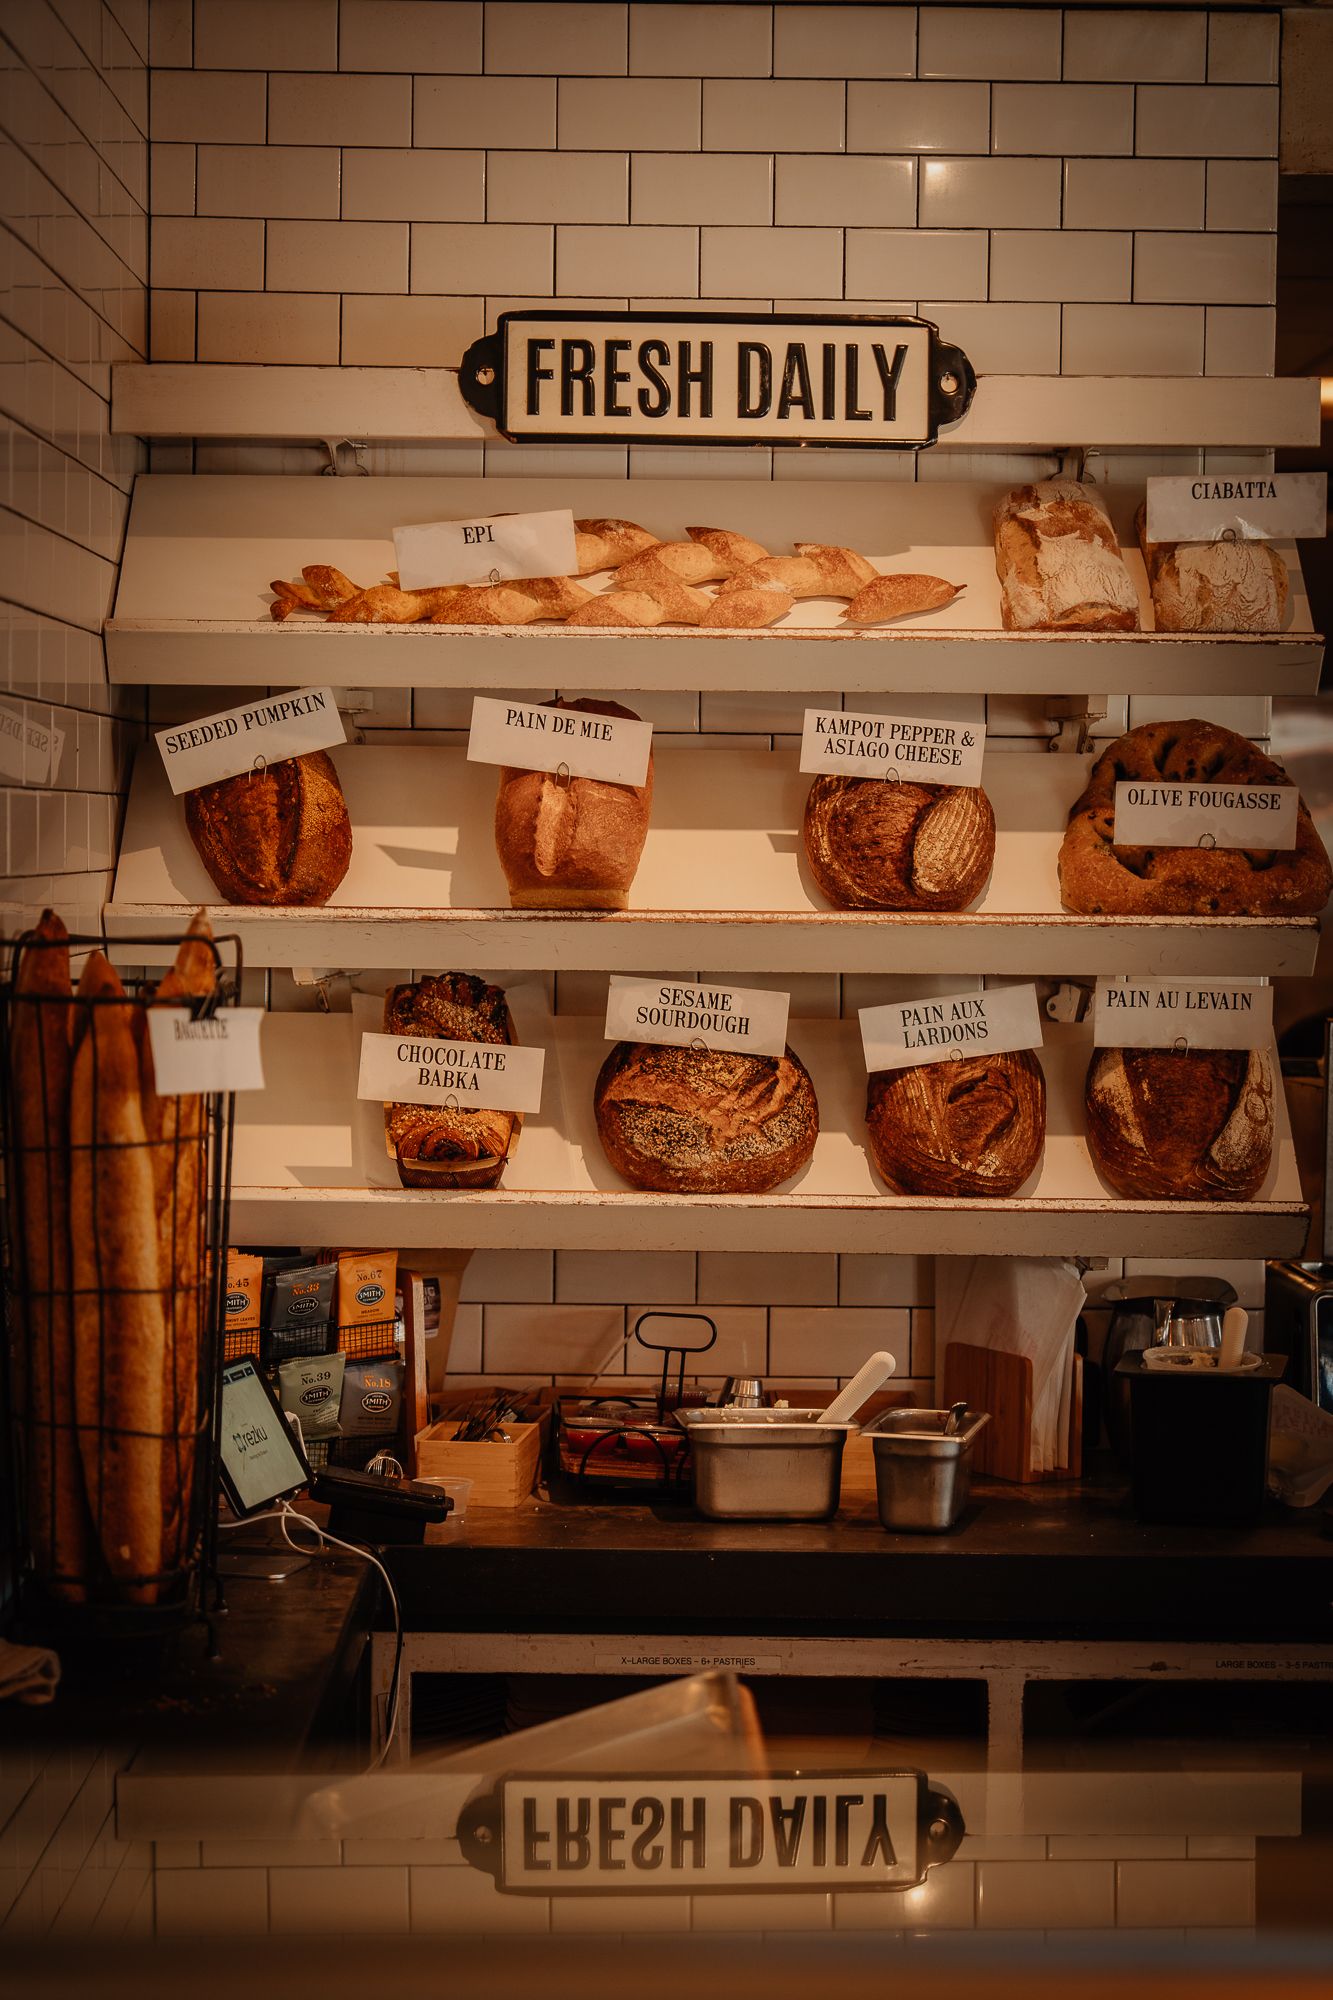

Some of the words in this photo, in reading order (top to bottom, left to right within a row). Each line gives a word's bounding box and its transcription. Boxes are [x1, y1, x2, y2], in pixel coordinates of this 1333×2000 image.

[526, 338, 713, 418] FRESH
[737, 341, 908, 421] DAILY
[1191, 482, 1277, 500] CIABATTA
[462, 524, 495, 545] EPI
[165, 719, 239, 755] SEEDED
[240, 693, 327, 733] PUMPKIN
[505, 708, 546, 730] PAIN
[551, 717, 576, 735] DE
[580, 721, 613, 742] MIE
[815, 717, 886, 739] KAMPOT
[889, 723, 958, 745] PEPPER
[960, 730, 976, 747] &
[823, 737, 890, 757] ASIAGO
[894, 743, 963, 766] CHEESE
[1127, 788, 1183, 807] OLIVE
[1188, 790, 1281, 810] FOUGASSE
[658, 987, 733, 1012] SESAME
[1106, 989, 1150, 1008] PAIN
[1156, 991, 1179, 1009] AU
[1184, 991, 1252, 1010] LEVAIN
[636, 1006, 750, 1036] SOURDOUGH
[900, 1008, 944, 1028] PAIN
[950, 999, 986, 1020] AUX
[903, 1021, 988, 1049] LARDONS
[396, 1043, 506, 1072] CHOCOLATE
[417, 1067, 480, 1091] BABKA
[291, 1301, 315, 1311] SMITH
[359, 1290, 381, 1300] SMITH
[304, 1390, 329, 1401] SMITH
[365, 1398, 389, 1406] SMITH
[243, 1425, 268, 1449] rezku
[621, 1657, 660, 1665] X-LARGE
[662, 1657, 692, 1665] BOXES
[701, 1657, 711, 1665] 6+
[713, 1657, 756, 1666] PASTRIES
[1215, 1660, 1245, 1669] LARGE
[1247, 1660, 1276, 1669] BOXES
